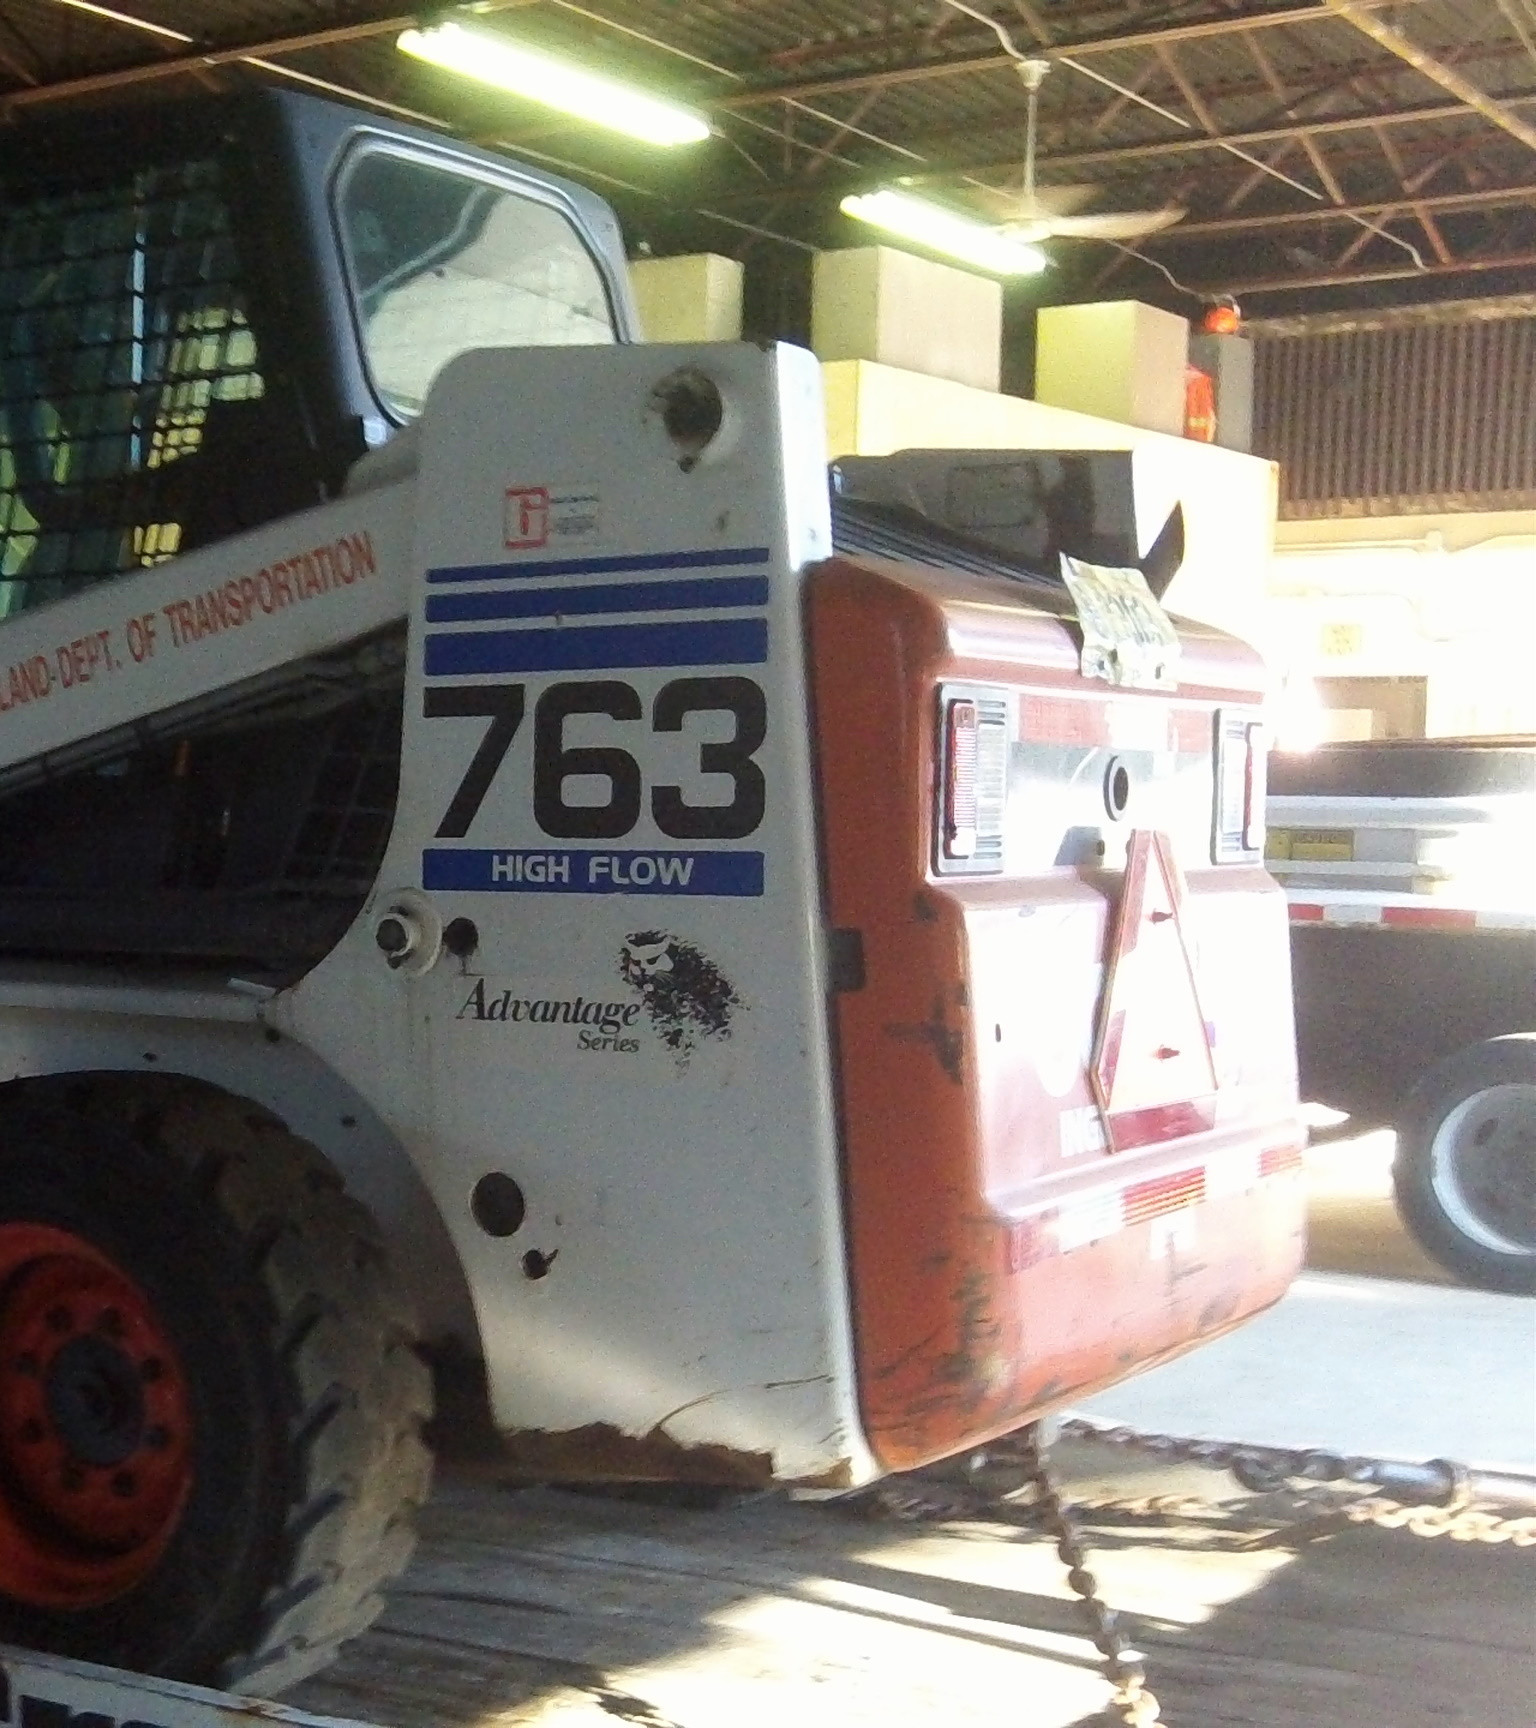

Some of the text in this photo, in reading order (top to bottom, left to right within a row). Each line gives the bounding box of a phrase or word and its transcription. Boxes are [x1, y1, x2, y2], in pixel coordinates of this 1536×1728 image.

[126, 613, 157, 662] OF
[163, 531, 376, 648] TRANSPORTATION
[422, 676, 767, 839] 763
[491, 855, 694, 886] HIGH FLOW
[456, 978, 641, 1034] Advantage
[577, 1030, 640, 1053] Series
